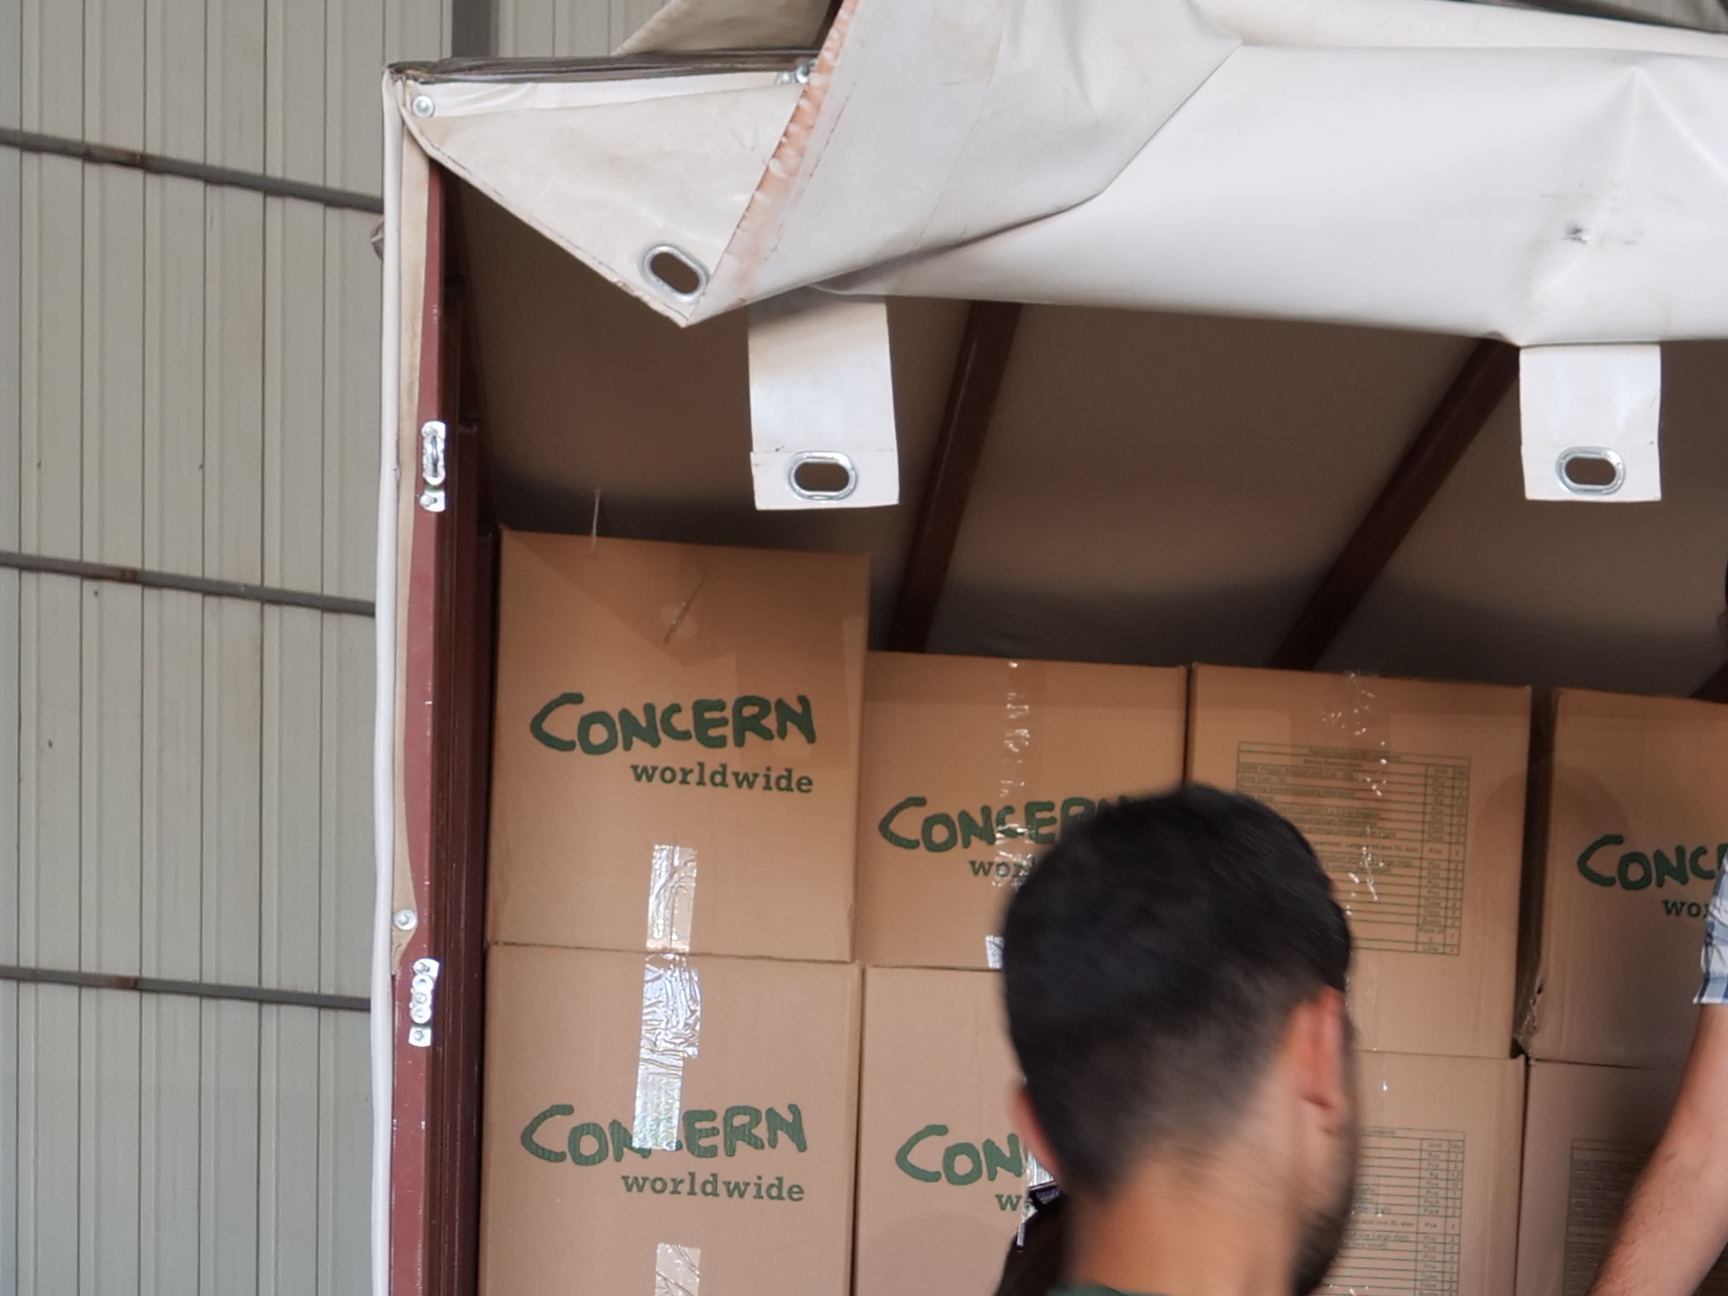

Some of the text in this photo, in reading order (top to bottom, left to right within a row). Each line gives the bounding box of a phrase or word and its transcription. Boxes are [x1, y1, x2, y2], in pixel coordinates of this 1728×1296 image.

[529, 692, 817, 755] CONCERN
[630, 762, 814, 794] worldwide
[878, 796, 1130, 853] CONCER
[1577, 834, 1728, 891] CONC
[520, 1104, 808, 1166] CONERN
[620, 1172, 804, 1201] worldwide
